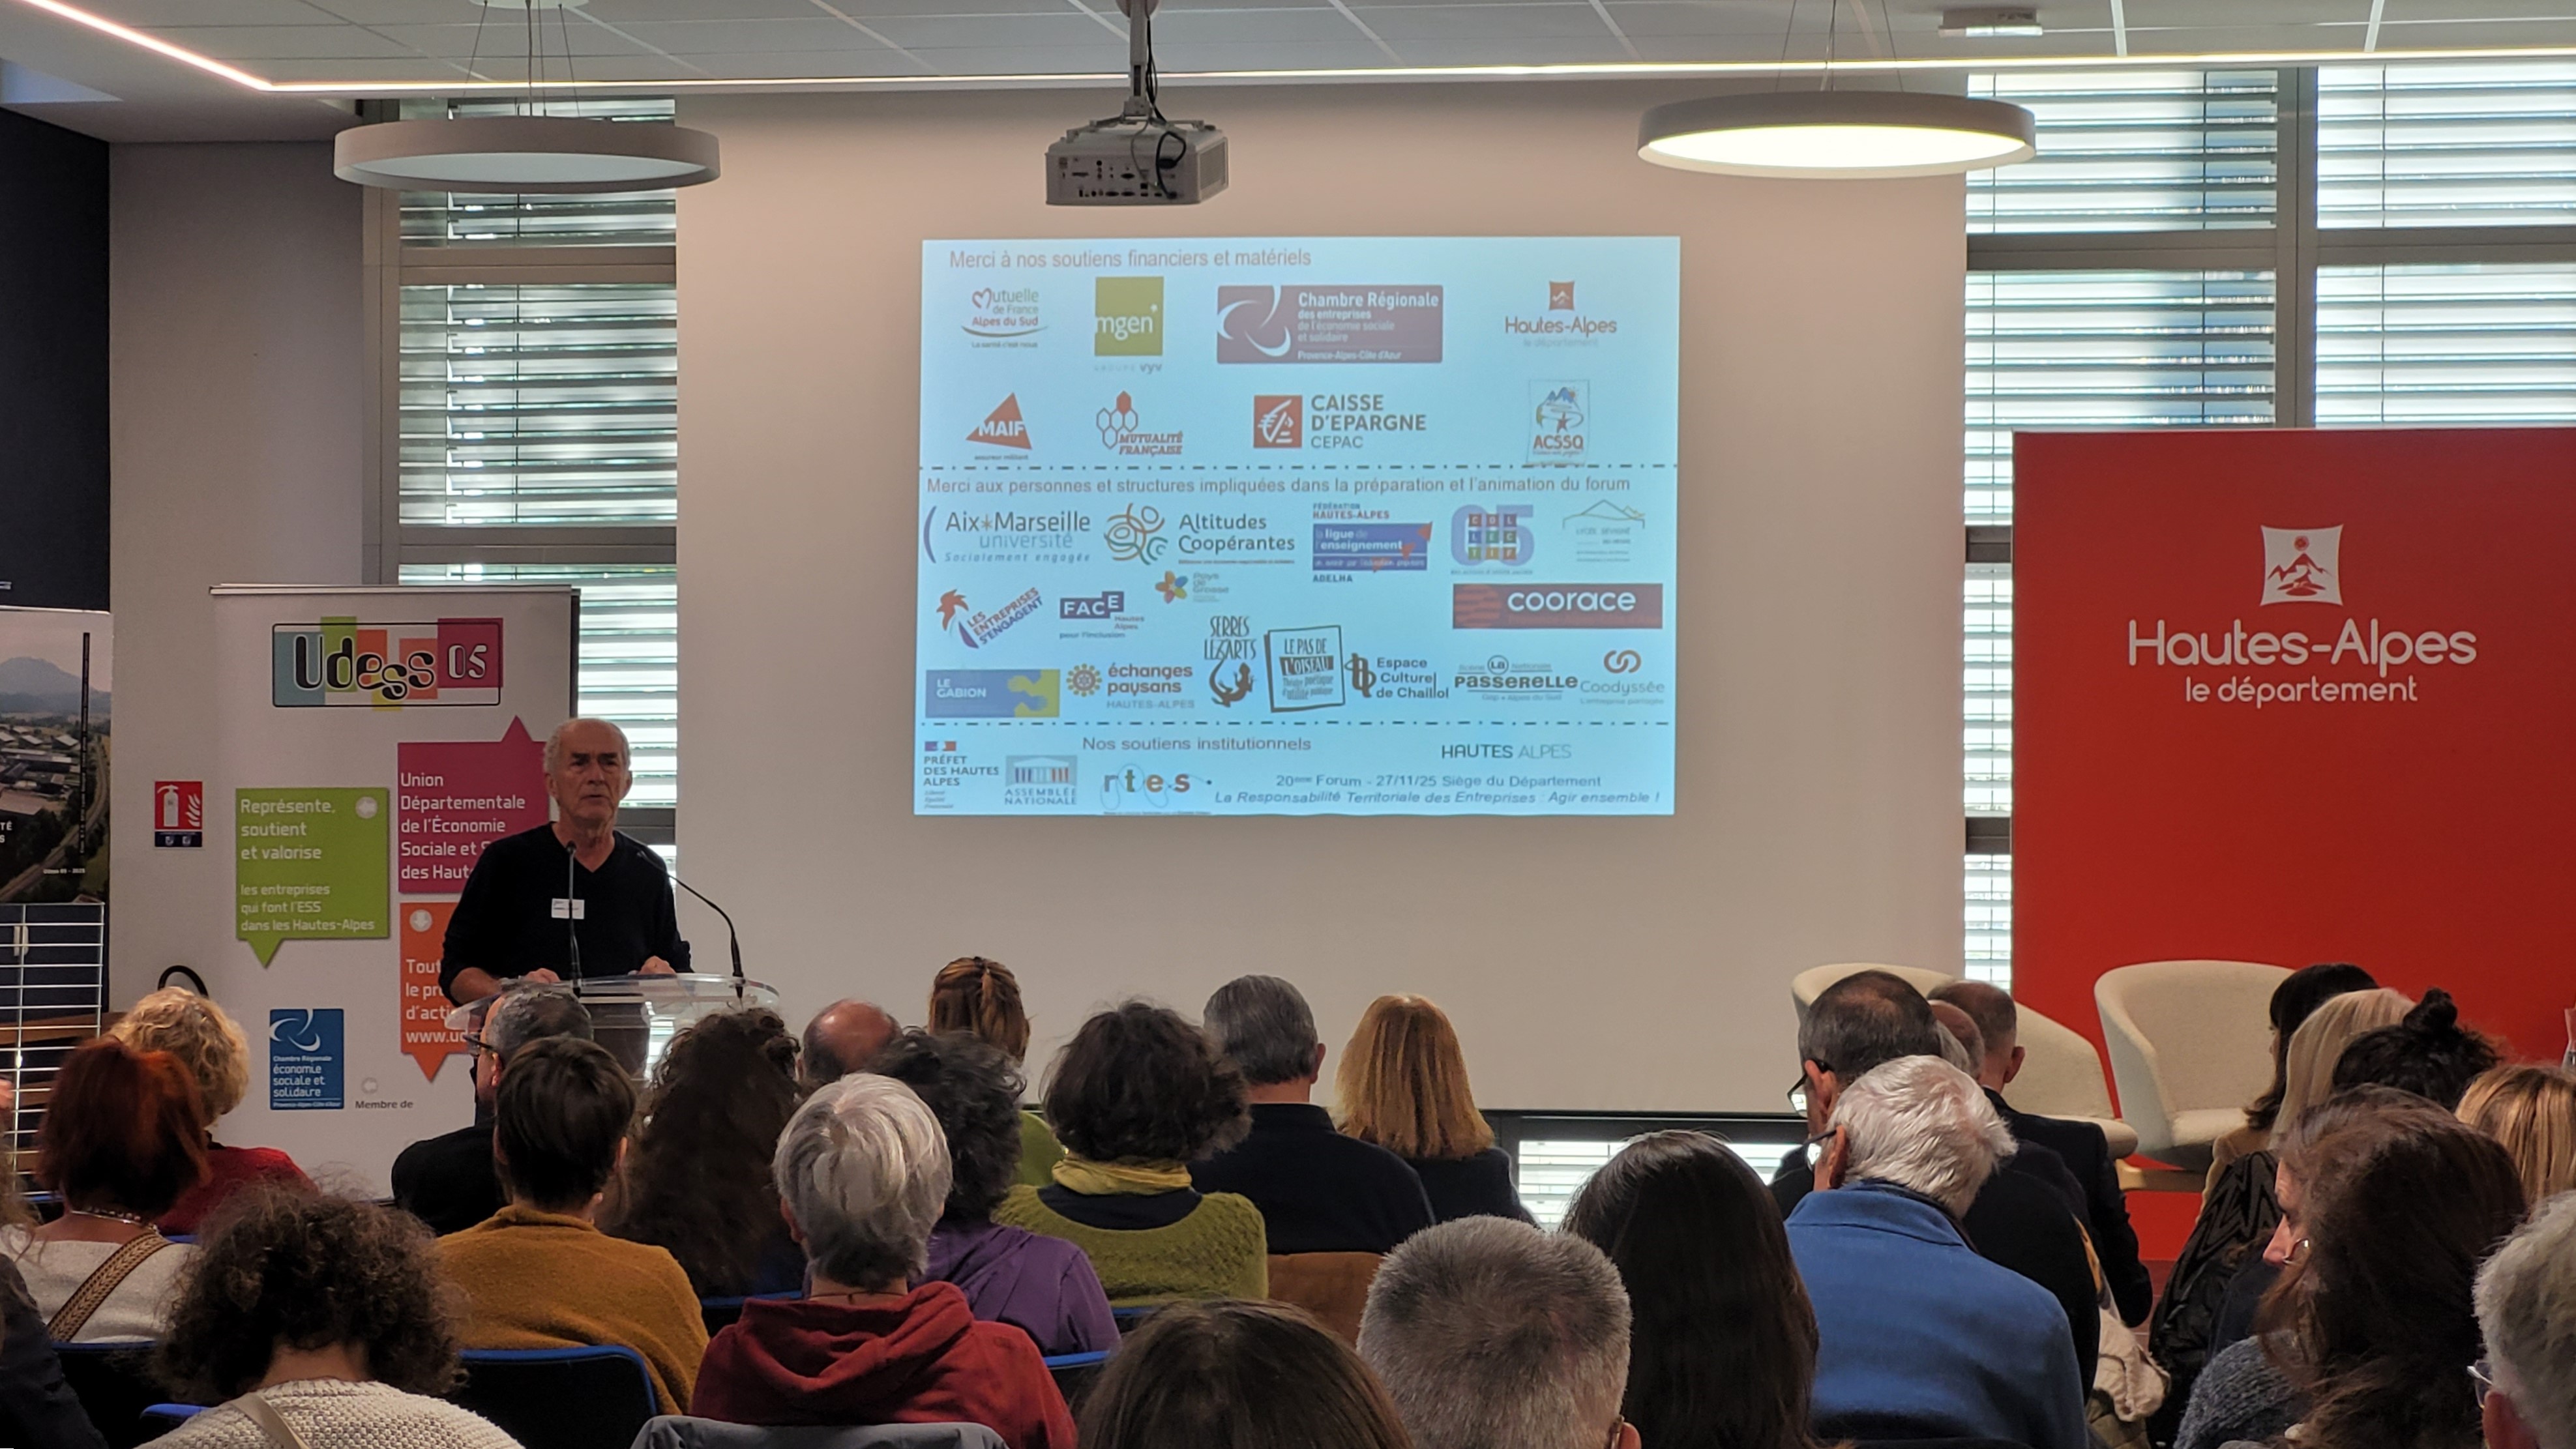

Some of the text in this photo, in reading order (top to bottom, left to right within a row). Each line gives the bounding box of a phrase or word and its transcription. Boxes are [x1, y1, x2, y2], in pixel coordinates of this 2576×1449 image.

[950, 248, 1311, 267] Merci à nos soutiens financiers et matériels
[972, 287, 1039, 309] Mutuelle
[1298, 291, 1439, 310] Chambre Régionale
[992, 304, 1039, 314] de France
[1297, 310, 1371, 320] des entreprises
[972, 315, 1039, 327] Alpes du Sud
[1095, 313, 1153, 340] mgen
[1505, 315, 1617, 338] Hautes-Alpes
[1297, 332, 1348, 342] et solidaire
[1310, 394, 1385, 411] CAISSE
[978, 420, 1025, 437] MAIF
[1310, 413, 1427, 432] D'EPARGNE
[1119, 430, 1183, 443] MUTUALITÉ
[1310, 435, 1363, 449] CEPAC
[1533, 435, 1584, 450] ACSSQ
[1118, 445, 1183, 457] FRANÇAISE
[927, 475, 1630, 495] Merci aux personnes et structures impliquées dans la préparation et l'animation du forum
[1312, 510, 1389, 519] HAUTES-ALPES
[1179, 513, 1267, 534] Altitudes
[979, 531, 1073, 549] université
[1325, 528, 1355, 540] ligue
[1178, 534, 1295, 554] Coopérantes
[945, 552, 1090, 564] Socialement engagée
[1312, 574, 1353, 583] ADELHA
[1063, 594, 1119, 615] FACE
[1507, 591, 1636, 612] coorace
[973, 587, 1040, 636] ENTREPRISES
[967, 611, 986, 628] LES
[979, 596, 1043, 645] S'ENGAGENT
[1210, 615, 1250, 637] SERRES
[1284, 637, 1327, 654] LE PAS DE
[2128, 618, 2478, 678] Hautes-Alpes
[293, 634, 488, 701] Udess 05
[1284, 656, 1329, 676] L'OISEAU
[1376, 657, 1428, 671] Espace
[1108, 663, 1193, 681] échanges
[1380, 672, 1437, 684] Culturel
[937, 679, 951, 688] LE
[1107, 680, 1182, 697] paysans
[1580, 680, 1665, 697] Coodyssée
[937, 688, 987, 699] GABION
[1376, 687, 1449, 699] de Chaillol
[2186, 675, 2418, 709] le département
[1106, 699, 1195, 709] HAUTES-ALPES
[1082, 737, 1312, 750] Nos soutiens institutionnels
[1442, 744, 1572, 759] HAUTES ALPES
[924, 754, 968, 765] PRÉFET
[923, 766, 999, 776] DES HAUTES
[400, 772, 444, 787] Union
[923, 777, 960, 786] ALPES
[1104, 768, 1191, 793] rtes
[1316, 774, 1362, 787] Forum
[1376, 774, 1437, 787] 27/11/25
[1442, 775, 1482, 789] Siège
[1486, 775, 1504, 787] du
[1509, 775, 1601, 789] Département
[1005, 787, 1076, 797] ASSEMBLÉE
[1215, 791, 1232, 804] La
[1236, 791, 1341, 806] Responsabilité
[1347, 791, 1421, 804] Territoriale
[1424, 791, 1451, 803] des
[1454, 791, 1536, 804] Entreprises
[1548, 791, 1577, 805] Agir
[1580, 791, 1650, 803] ensemble
[400, 794, 526, 813] Départementale
[1004, 797, 1077, 806] NATIONALE
[241, 821, 307, 836] soutient
[401, 815, 506, 833] de l'Économie
[241, 845, 322, 859] et valorise
[401, 842, 456, 856] Sociale
[460, 842, 477, 856] et
[401, 864, 429, 879] des
[241, 884, 331, 897] les entreprises
[241, 901, 321, 915] qui font l'ESS
[241, 918, 375, 933] dans les Hautes-Alpes
[406, 982, 419, 997] le
[273, 1064, 322, 1074] économie
[273, 1076, 325, 1086] sociale et
[273, 1087, 321, 1098] solidaire
[355, 1100, 414, 1109] Membre de
